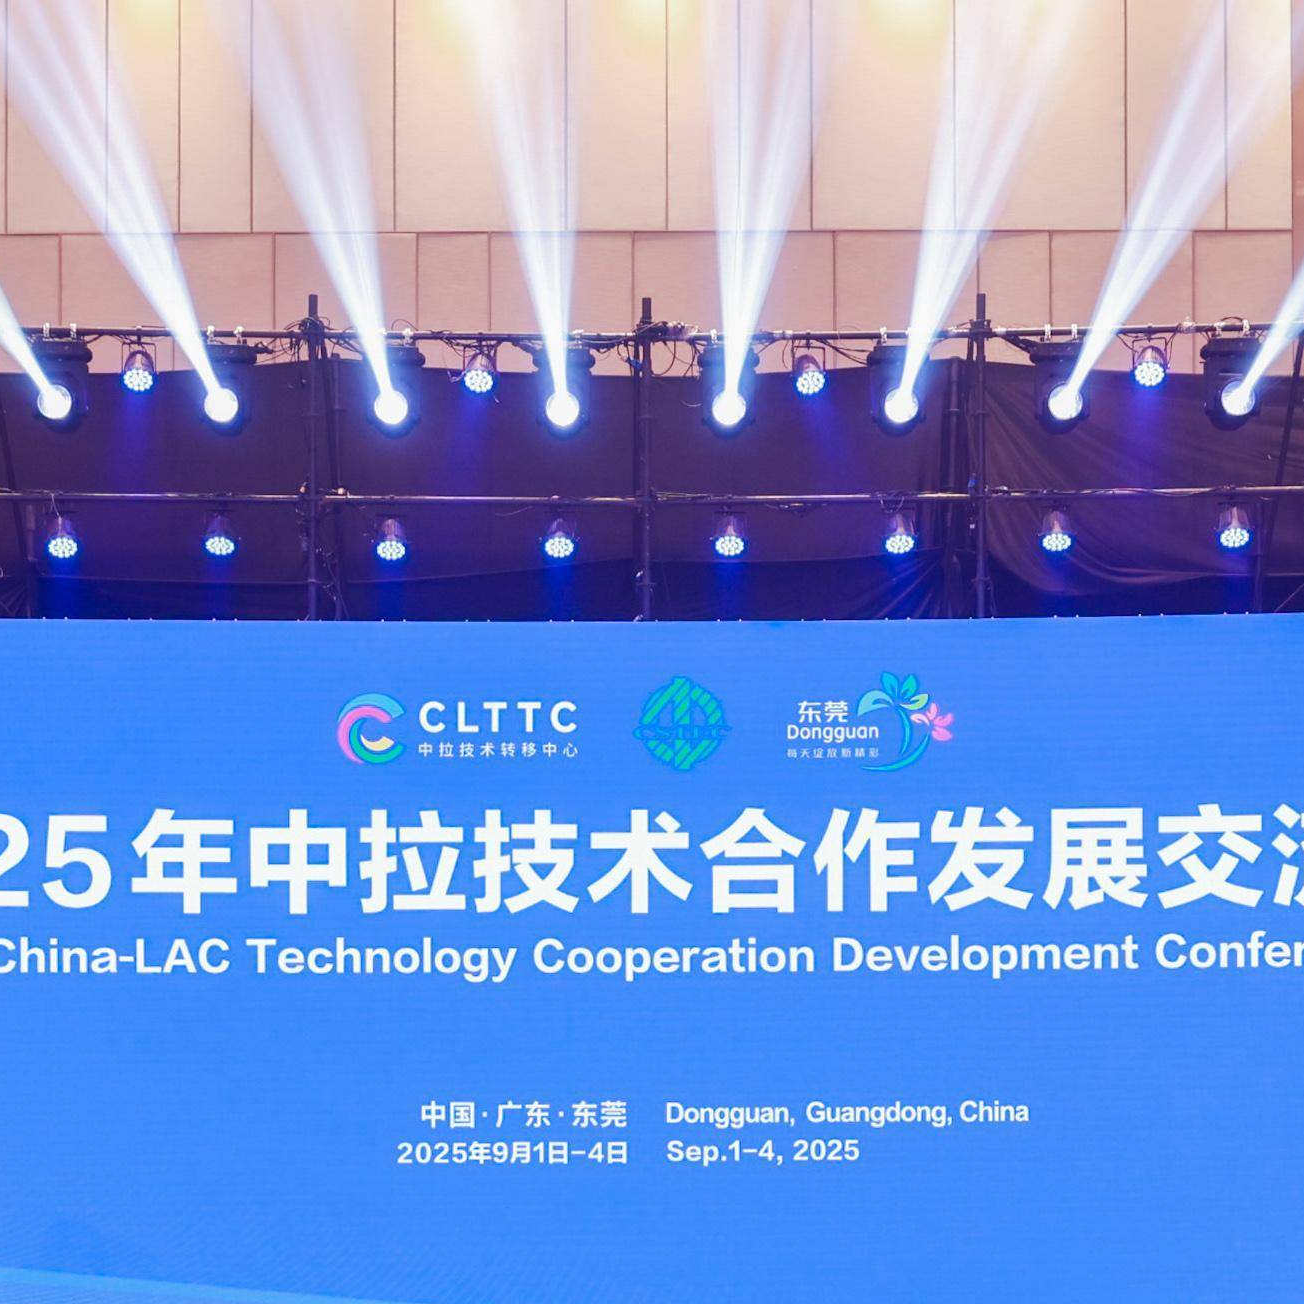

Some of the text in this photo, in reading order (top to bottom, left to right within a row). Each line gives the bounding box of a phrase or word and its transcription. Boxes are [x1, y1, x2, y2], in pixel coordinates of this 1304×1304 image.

[420, 702, 577, 733] CLTTC
[798, 701, 848, 723] 东莞
[787, 725, 879, 743] Dongguan
[418, 742, 578, 758] 中拉技术转移中心
[246, 937, 517, 983] Technology
[533, 937, 814, 982] Cooperation
[833, 934, 1139, 979] Development
[666, 1100, 1029, 1129] Dongguan, Guangdong, China
[793, 1139, 860, 1161] 2025
